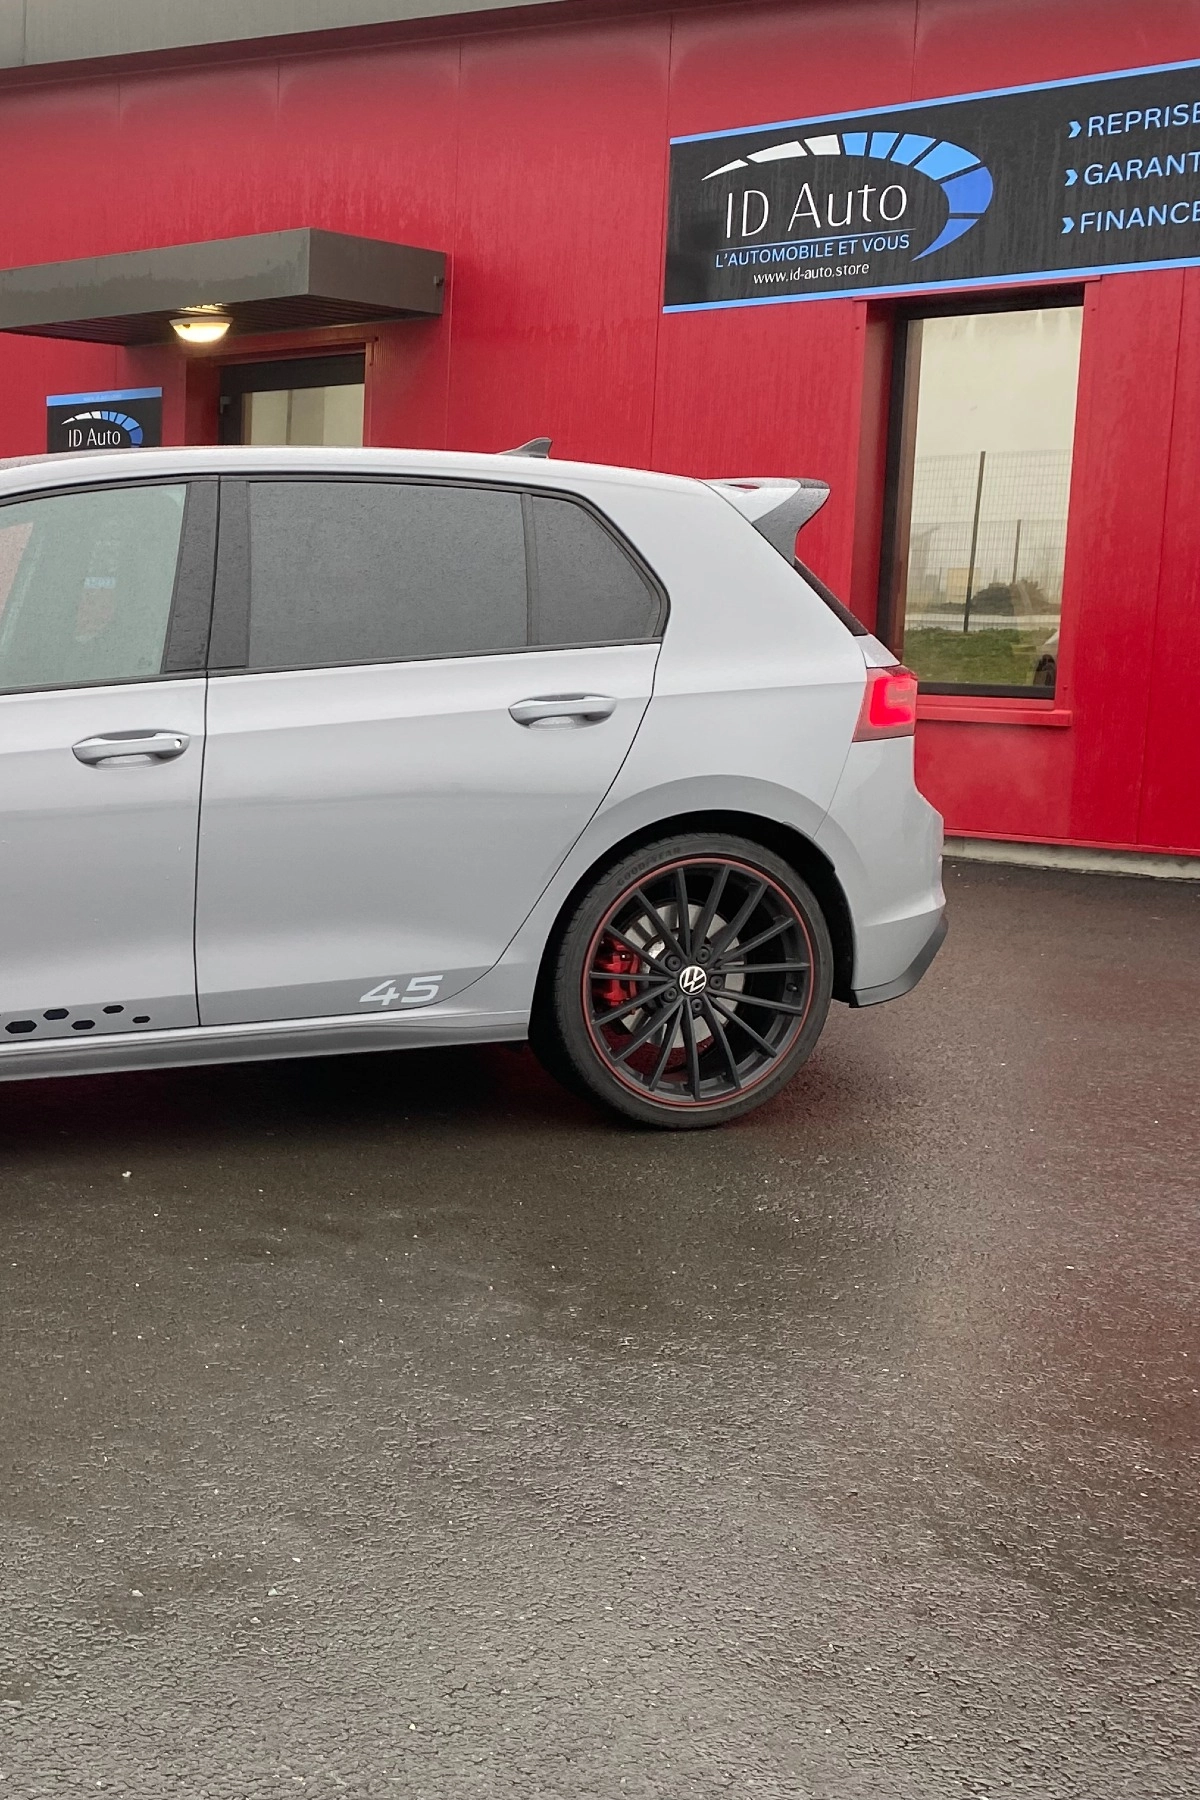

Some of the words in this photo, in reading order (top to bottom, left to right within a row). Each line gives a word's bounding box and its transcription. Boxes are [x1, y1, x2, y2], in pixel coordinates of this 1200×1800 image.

[726, 189, 770, 239] ID
[787, 182, 908, 232] Auto
[715, 241, 834, 268] L'AUTOMOBILE
[839, 239, 859, 255] ET
[863, 234, 910, 252] VOUS
[753, 262, 870, 284] www.id-auto.store
[68, 428, 82, 447] ID
[87, 427, 121, 446] Auto
[359, 974, 444, 1006] 45
